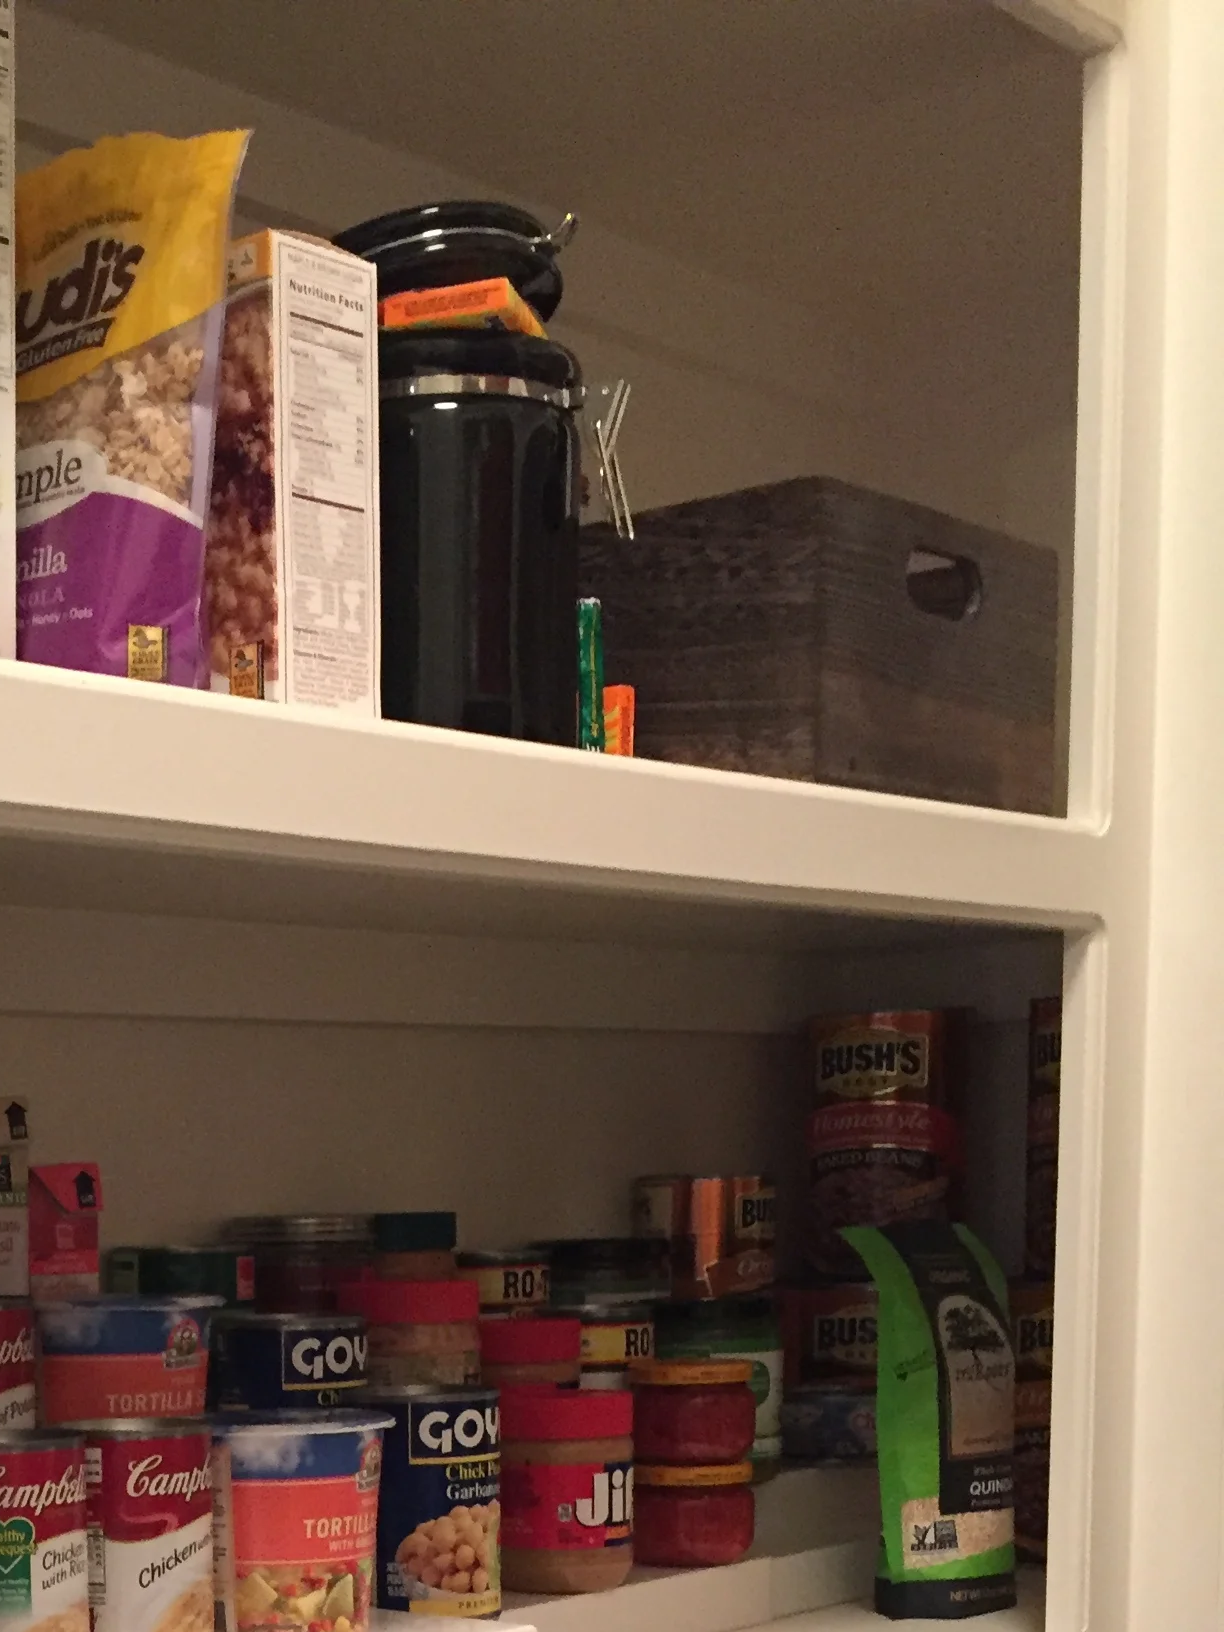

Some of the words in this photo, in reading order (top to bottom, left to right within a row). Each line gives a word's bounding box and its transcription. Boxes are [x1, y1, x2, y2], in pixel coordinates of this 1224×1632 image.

[289, 278, 336, 304] Nutrition
[339, 294, 364, 312] Facts
[820, 1039, 923, 1081] BUSH'S
[445, 1463, 486, 1482] Chick
[42, 1569, 68, 1591] with
[139, 1540, 198, 1589] Chicken
